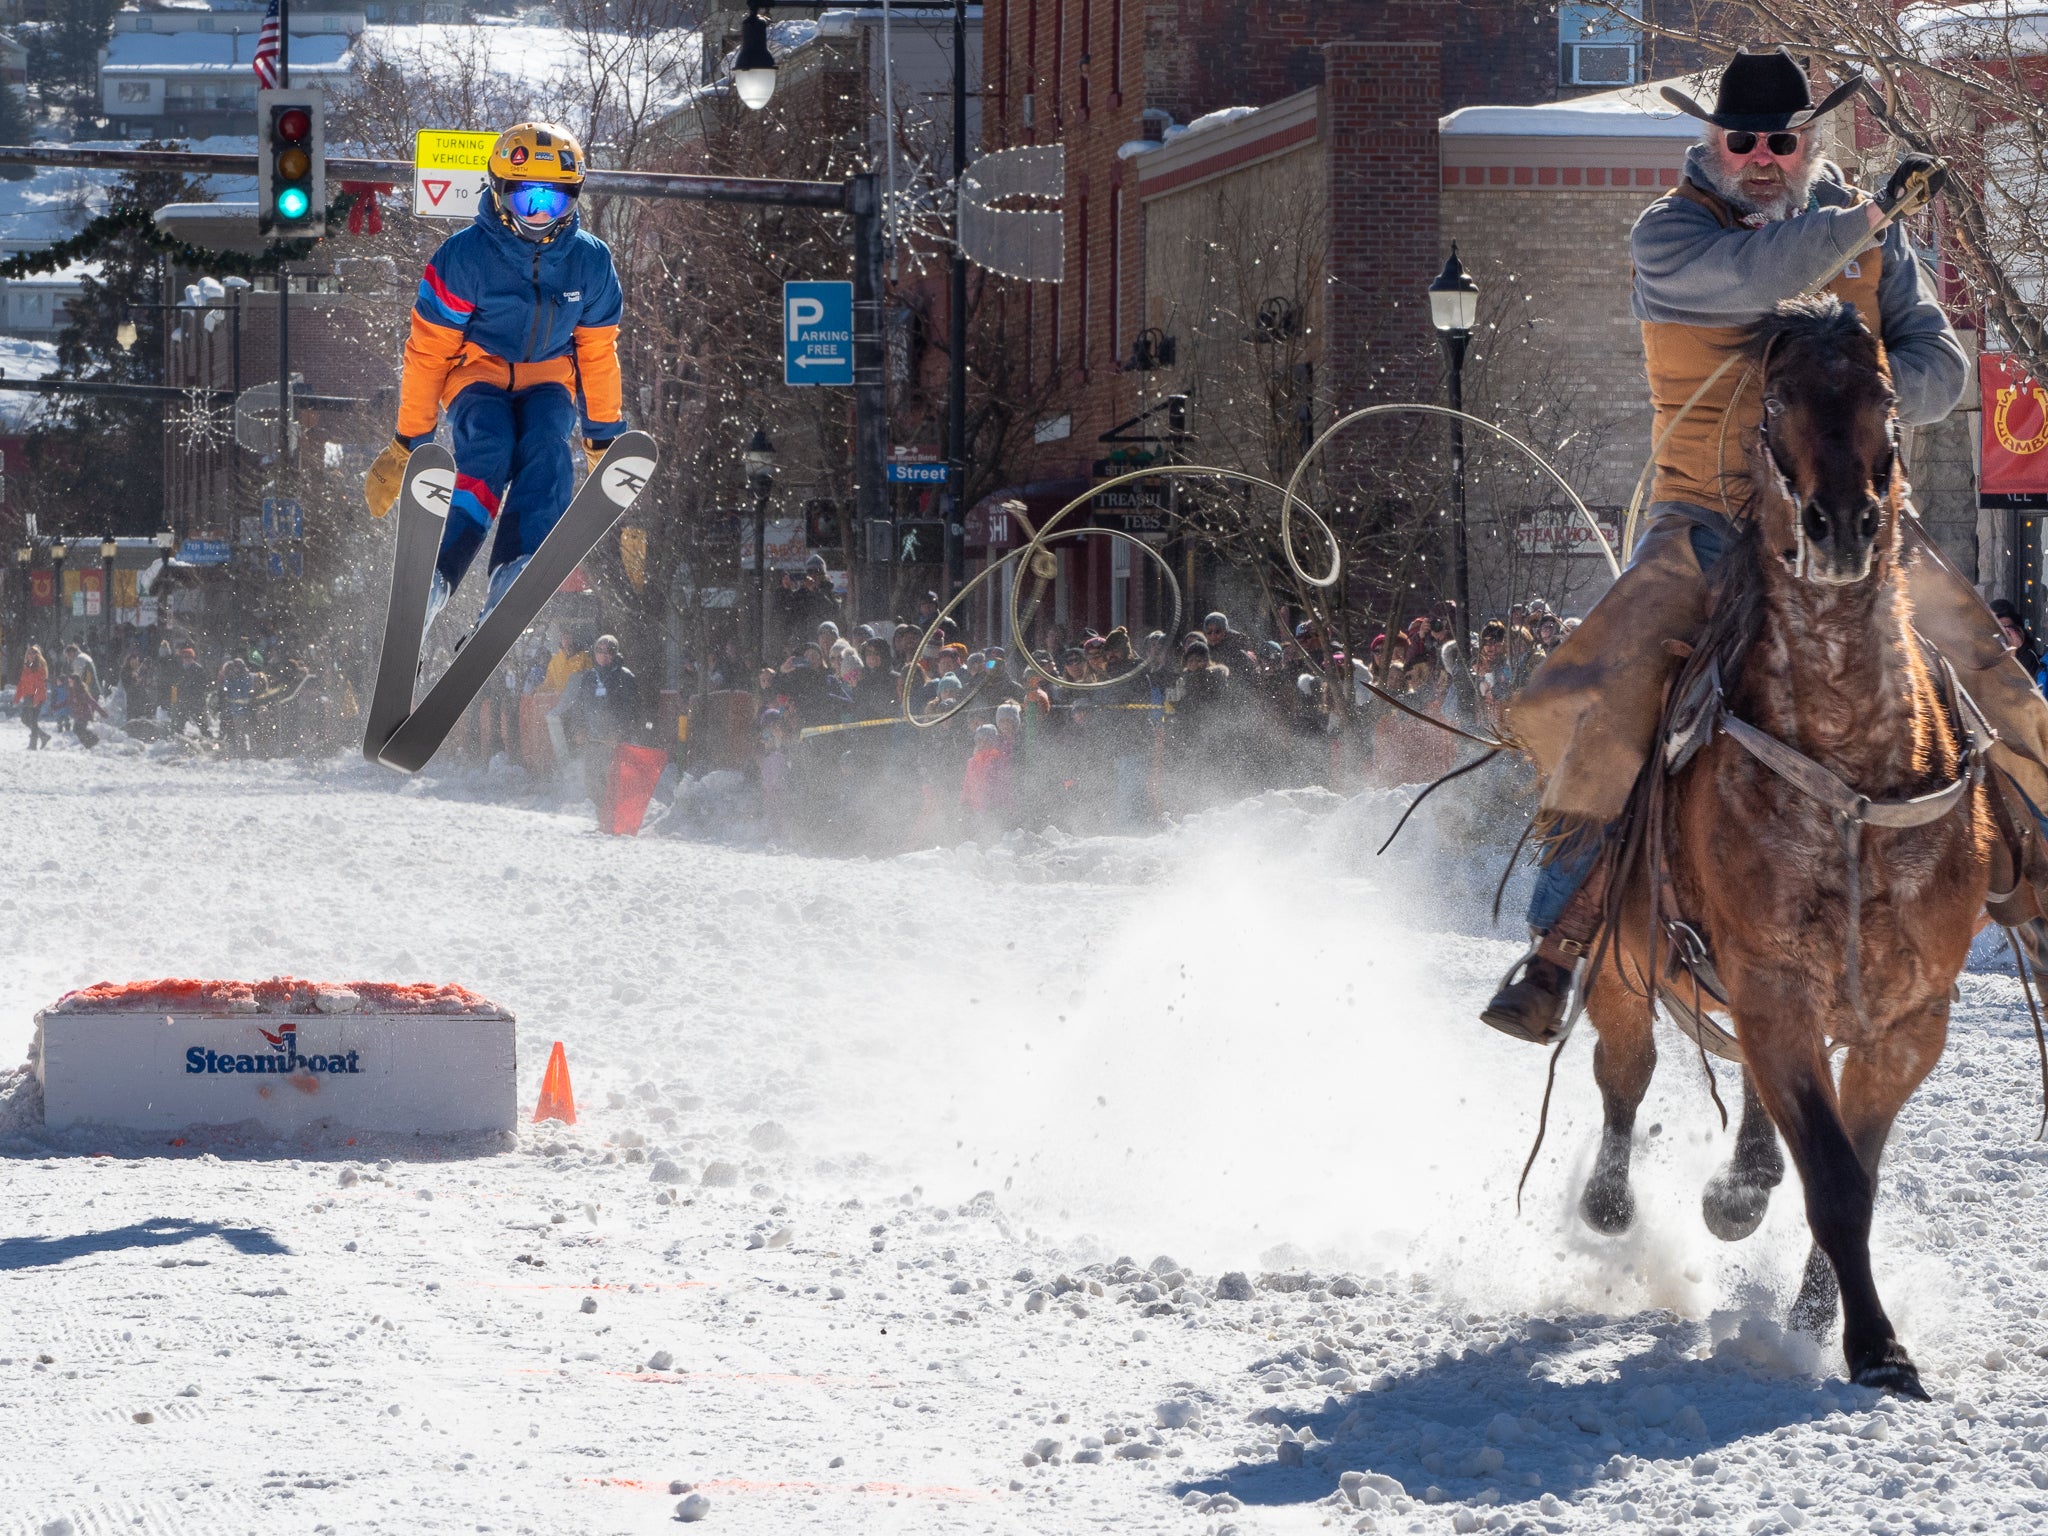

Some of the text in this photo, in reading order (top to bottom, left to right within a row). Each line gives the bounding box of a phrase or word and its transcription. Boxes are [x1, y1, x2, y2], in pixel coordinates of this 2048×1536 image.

[436, 138, 485, 150] TURNING
[432, 153, 487, 166] VEHICLES
[455, 188, 468, 199] TO
[807, 344, 838, 355] FREE
[896, 466, 946, 480] Street
[1122, 514, 1161, 530] TEES
[186, 1033, 360, 1074] Steamboat
